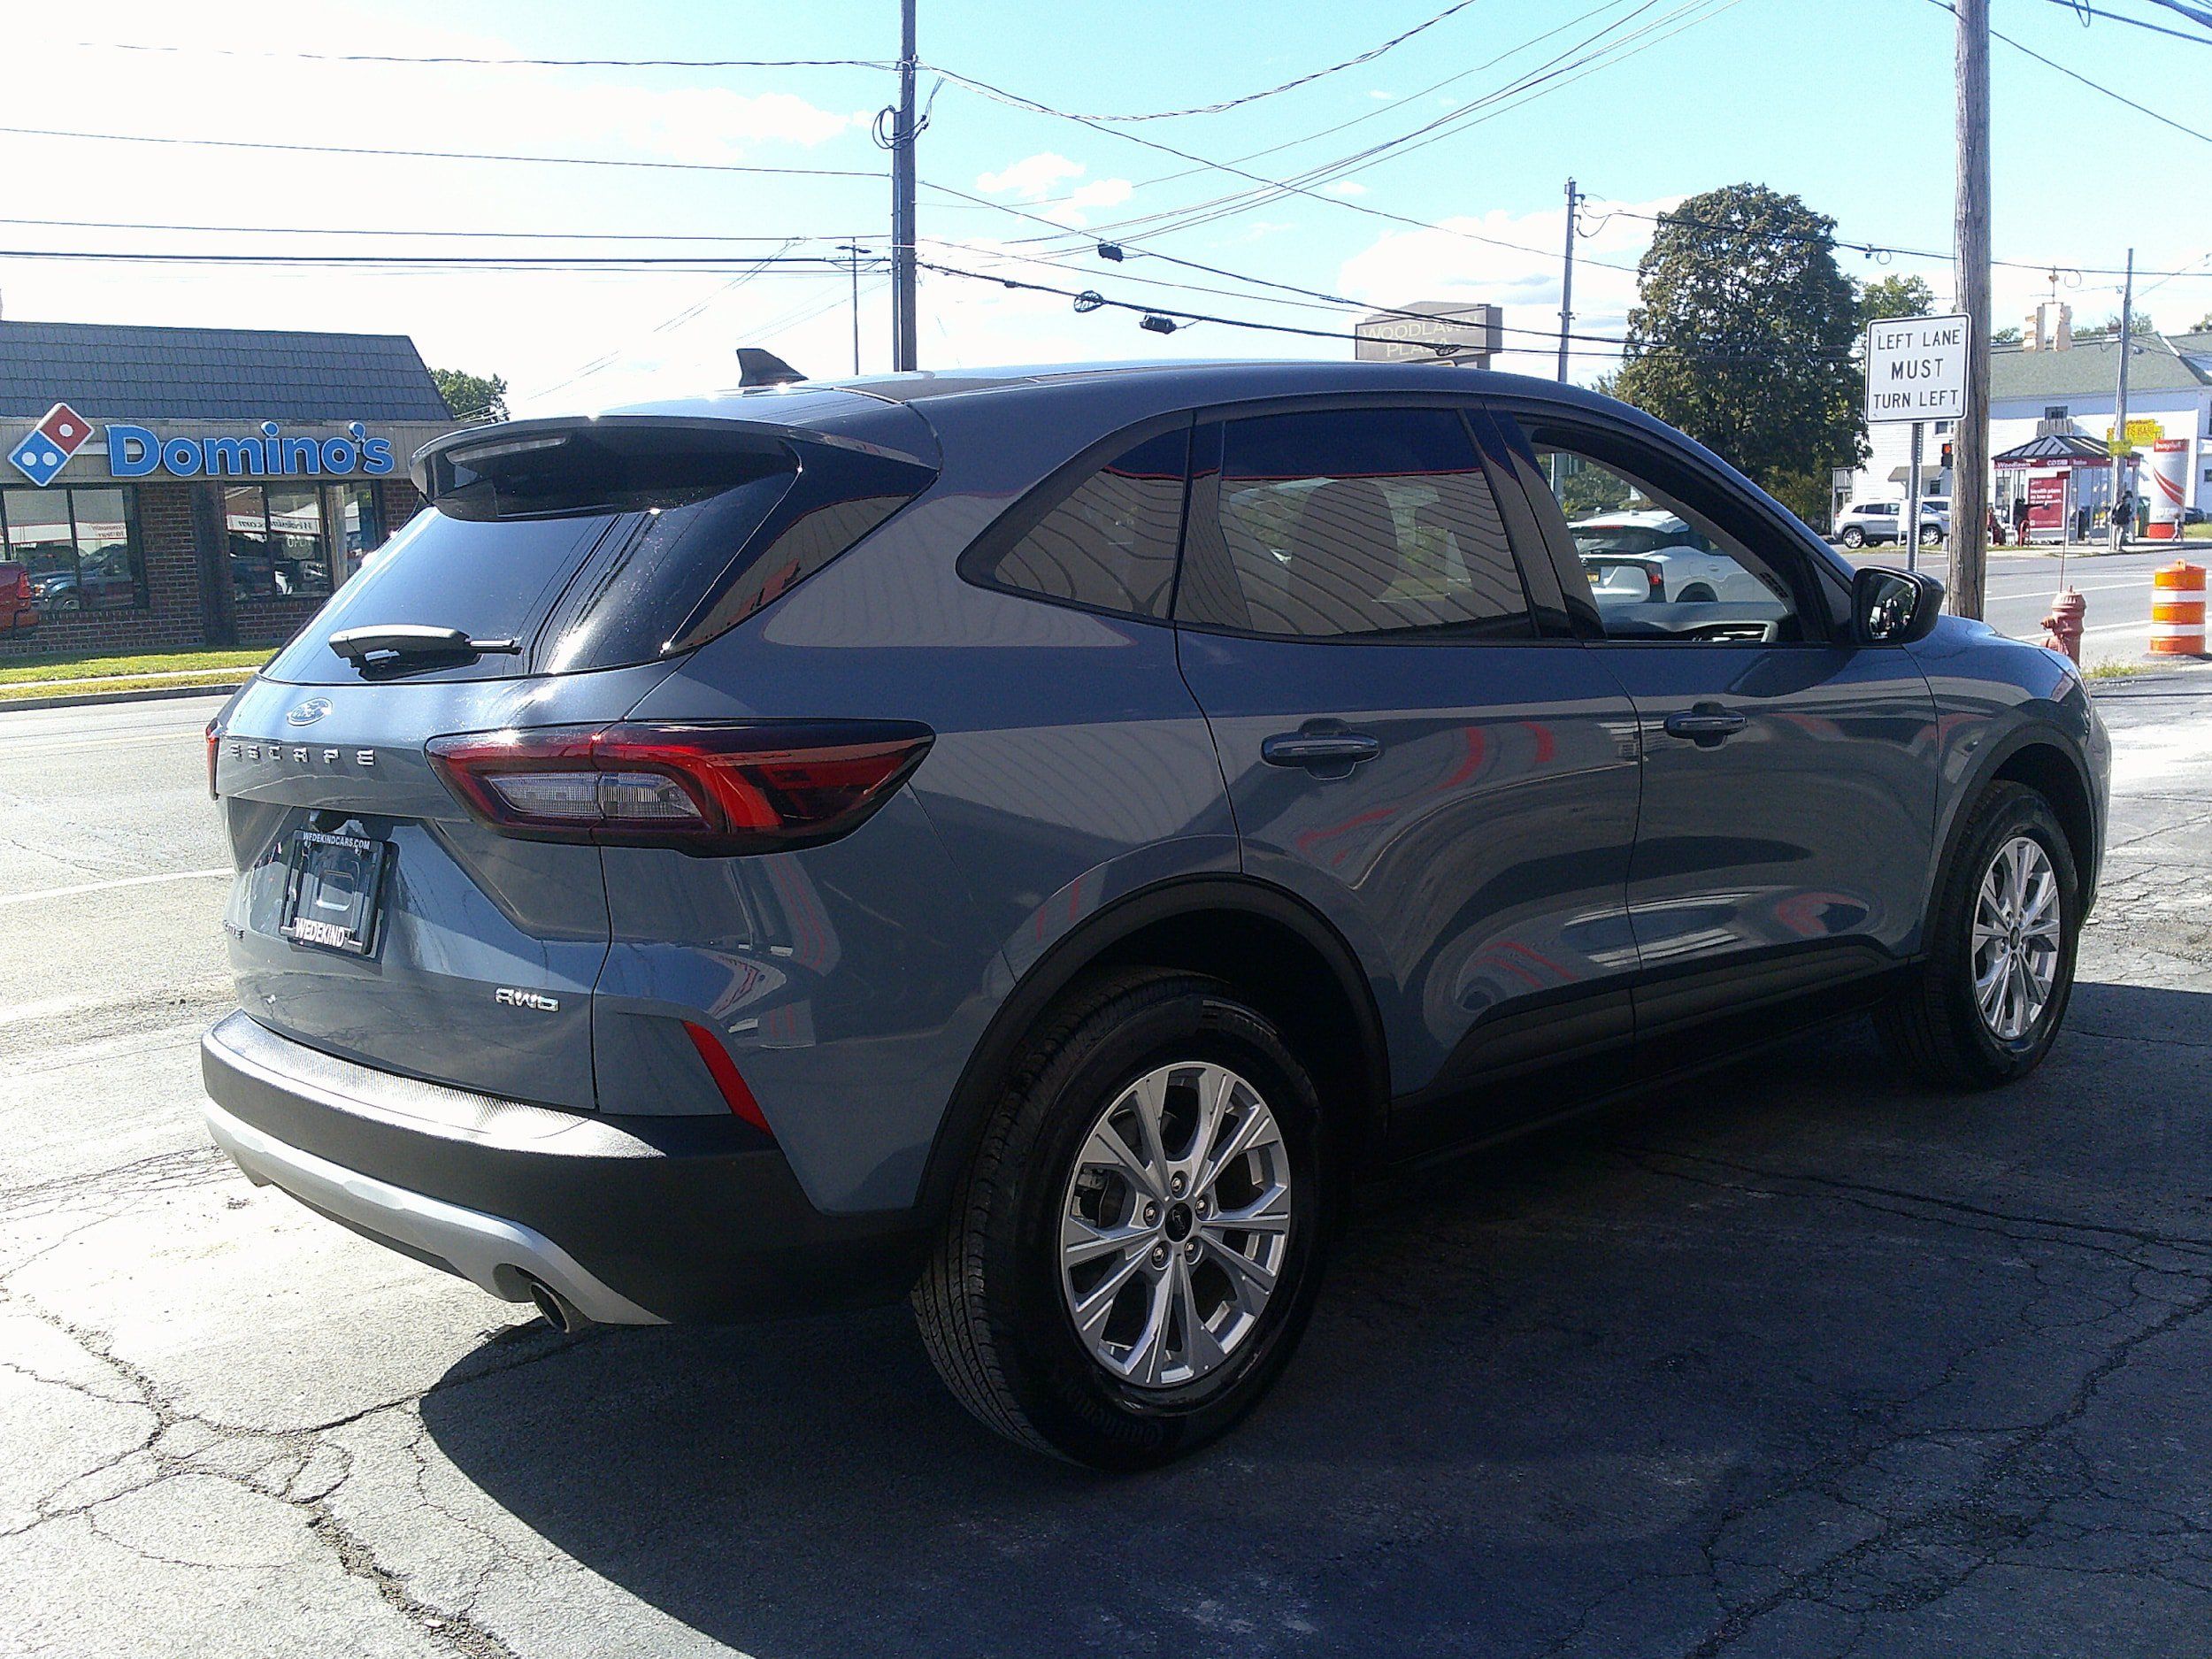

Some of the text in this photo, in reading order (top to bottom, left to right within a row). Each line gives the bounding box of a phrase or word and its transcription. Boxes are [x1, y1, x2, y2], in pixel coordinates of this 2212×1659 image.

[1878, 329, 1961, 350] LEFT LANE
[1891, 358, 1944, 380] MUST
[1873, 389, 1959, 409] TURN LEFT
[104, 421, 396, 477] Domino's
[303, 832, 371, 850] WEDEKINDCARS.COM
[295, 918, 345, 948] WEDEKIND
[495, 987, 559, 1012] AWD
